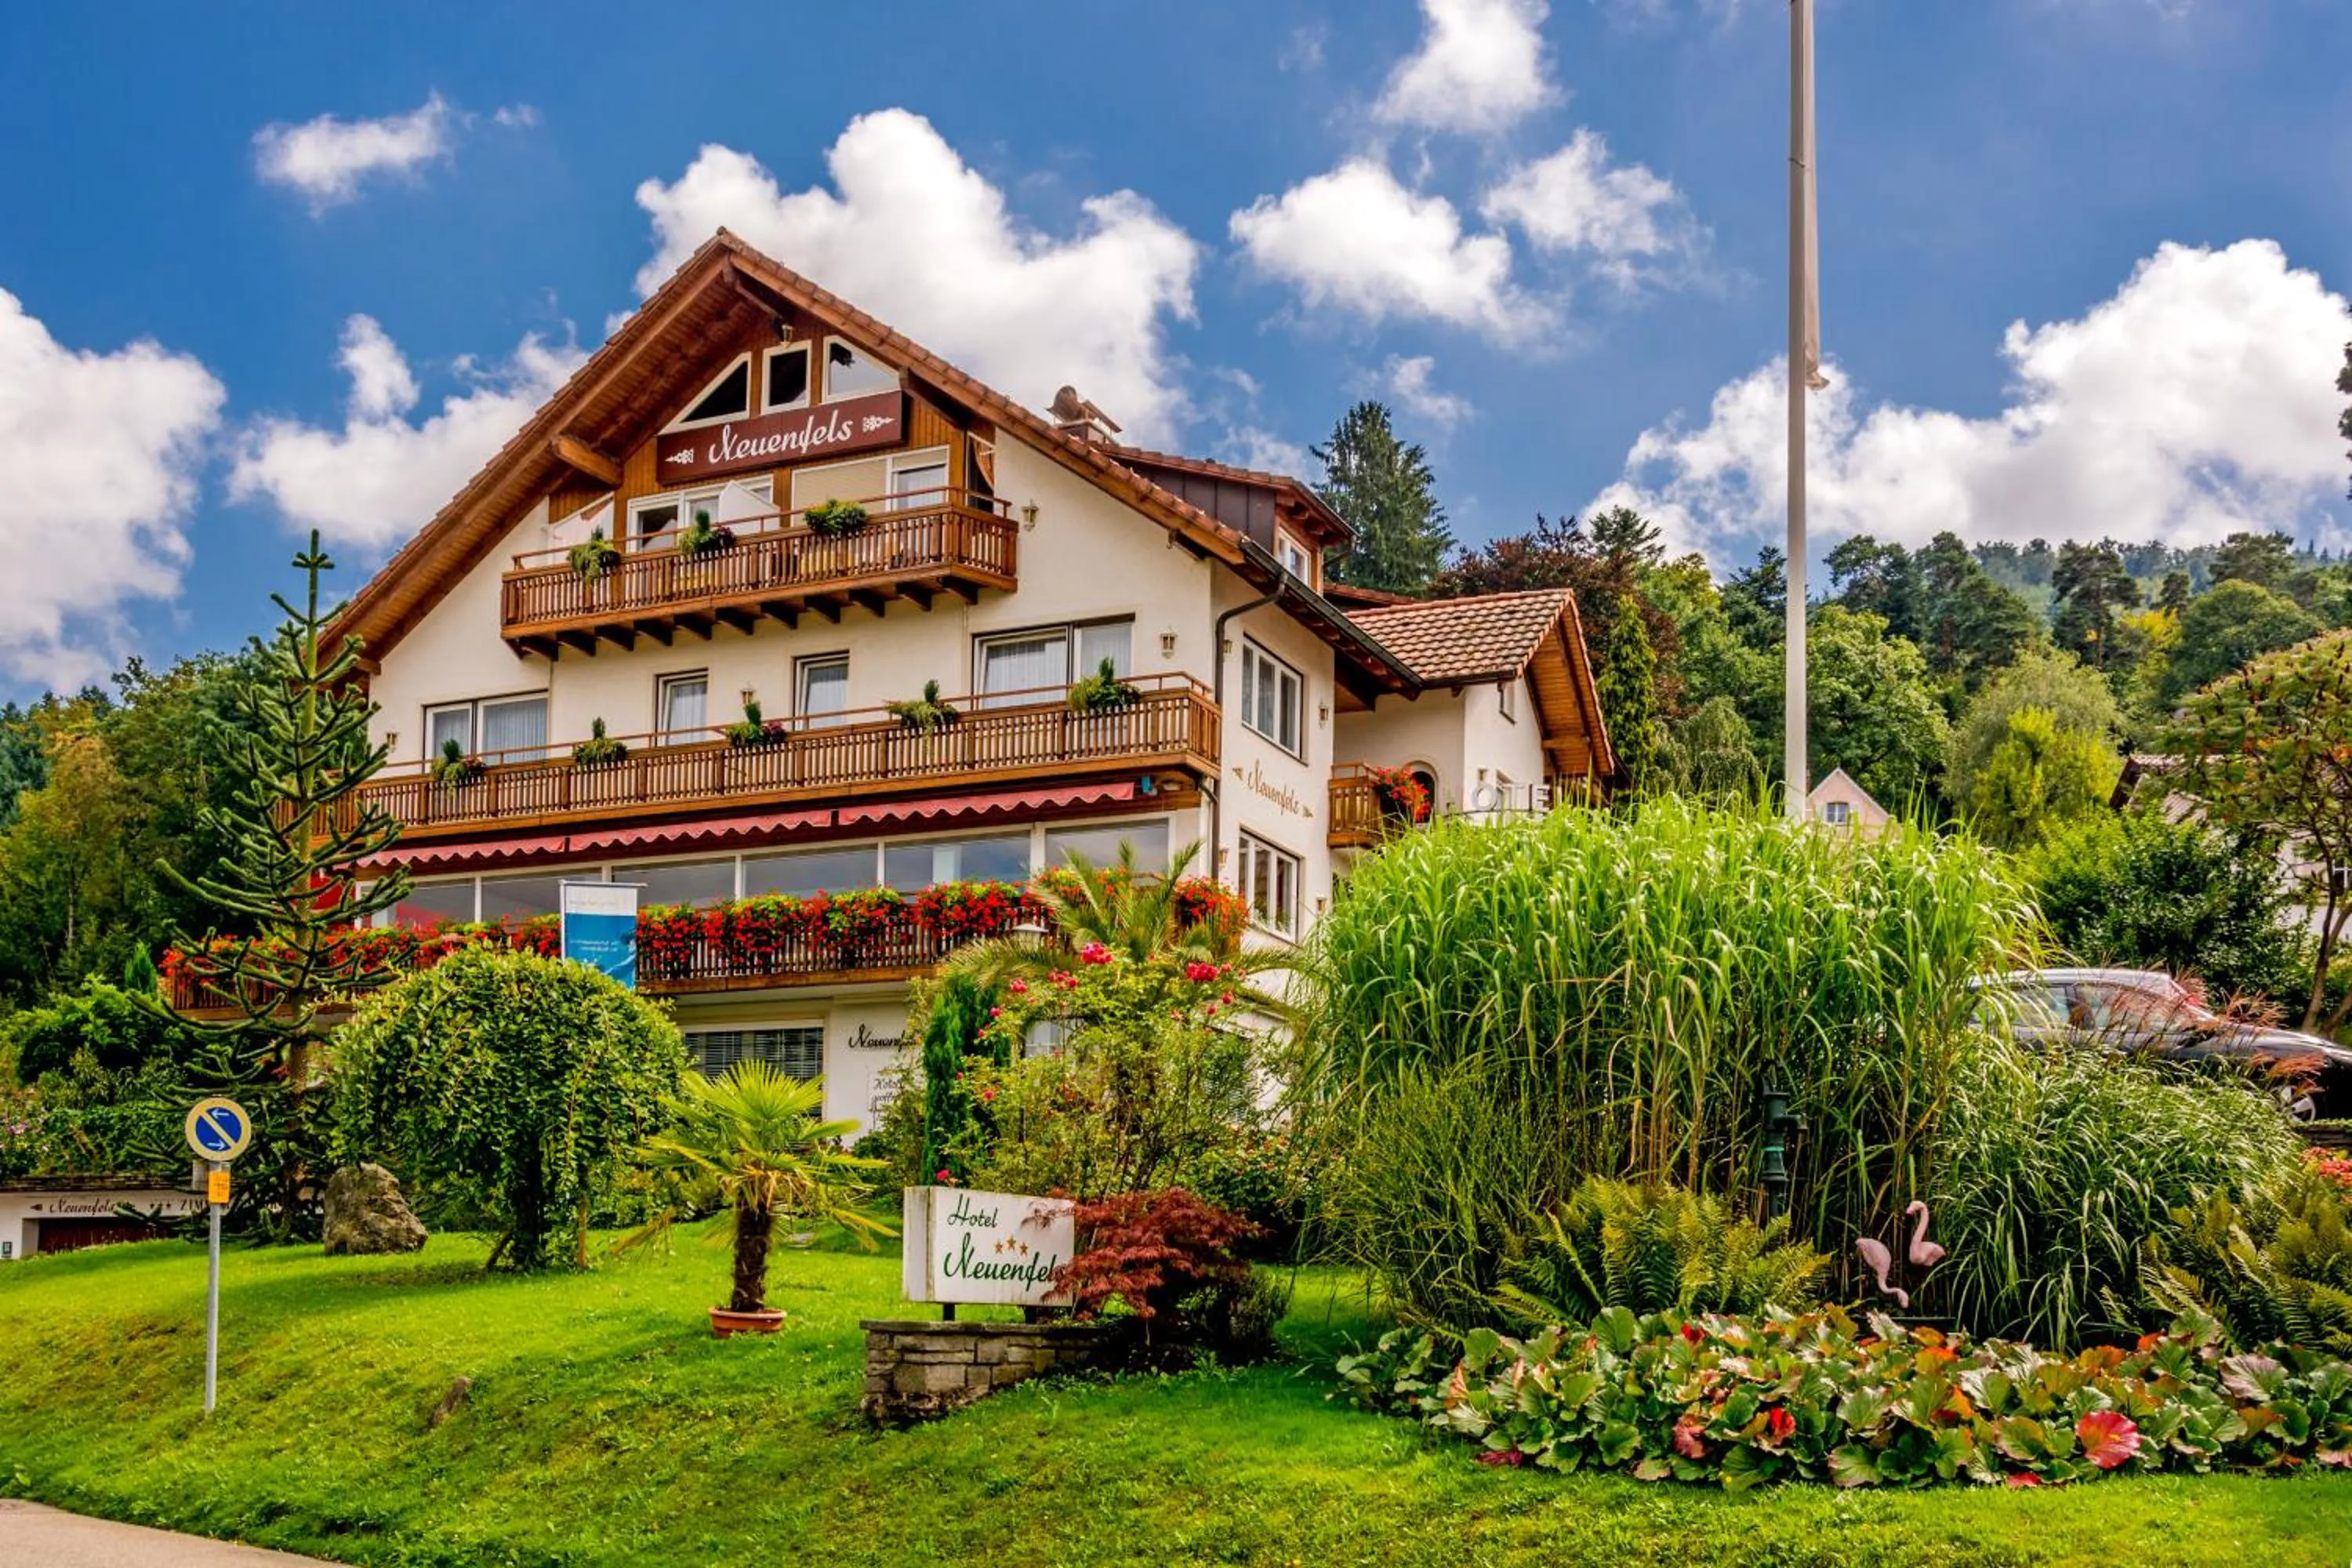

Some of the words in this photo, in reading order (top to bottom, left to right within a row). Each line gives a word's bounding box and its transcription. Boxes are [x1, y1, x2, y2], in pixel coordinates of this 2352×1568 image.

[708, 408, 854, 464] Neuenfels
[1247, 758, 1299, 816] Neuenfels
[946, 1192, 998, 1229] Hotel
[943, 1232, 1065, 1292] Neuenfel
